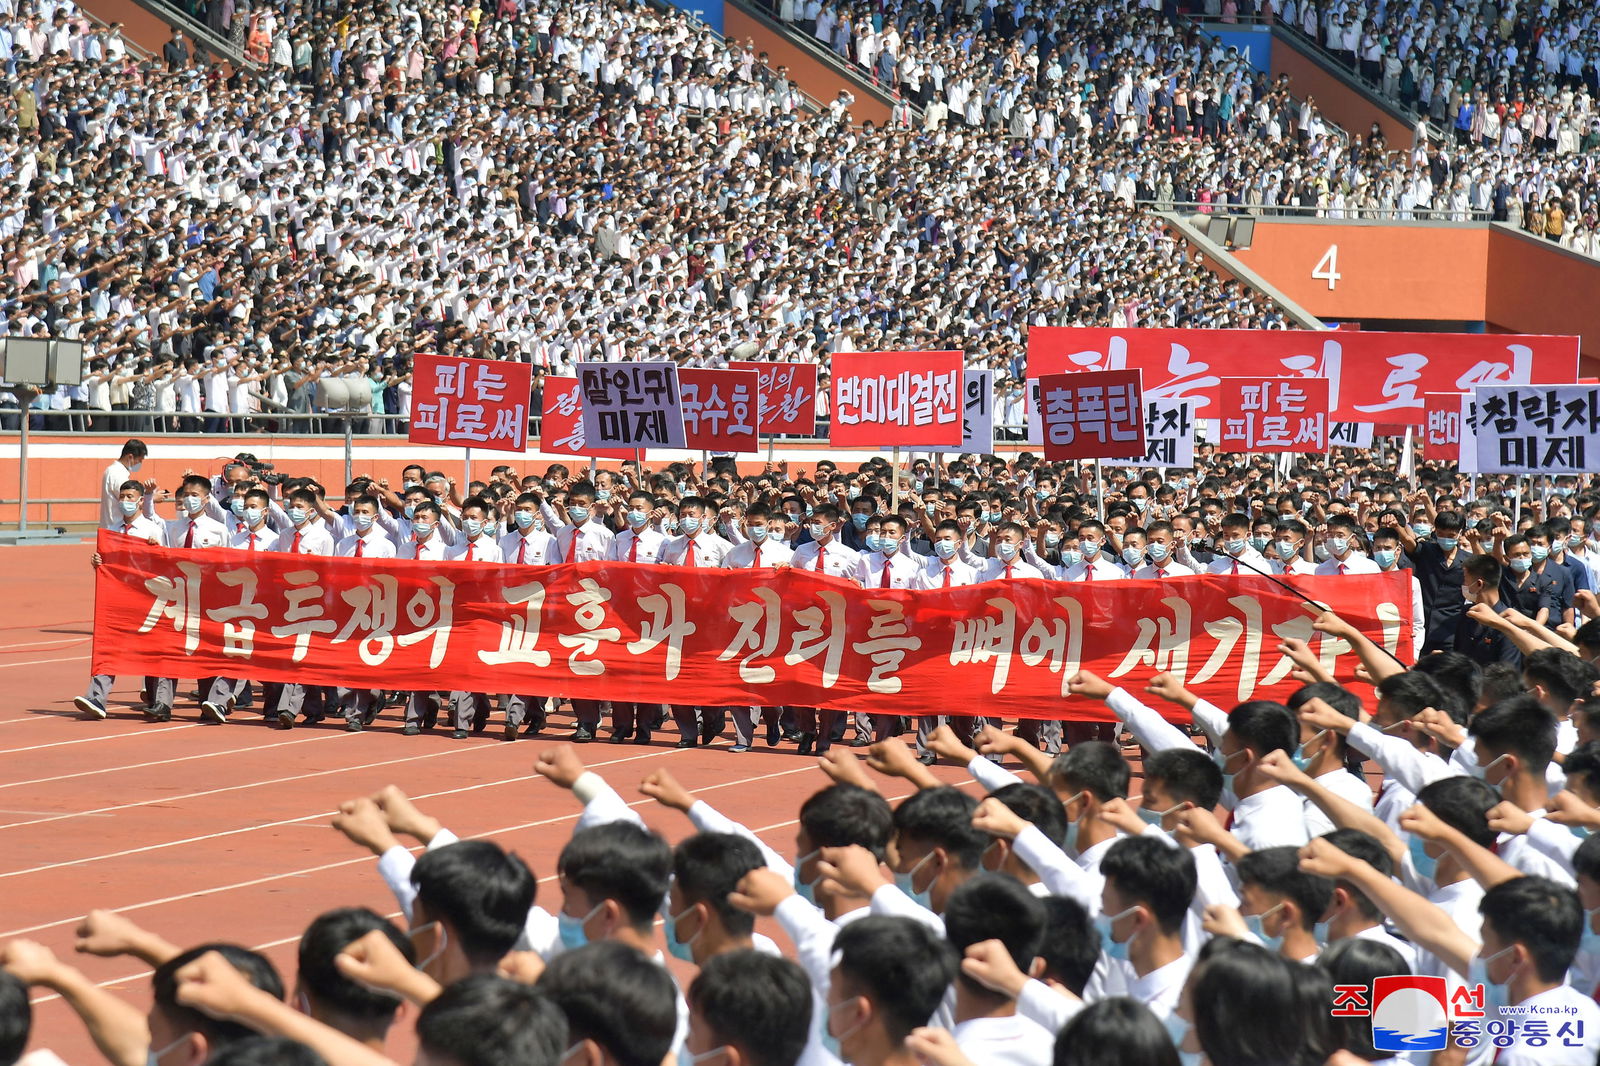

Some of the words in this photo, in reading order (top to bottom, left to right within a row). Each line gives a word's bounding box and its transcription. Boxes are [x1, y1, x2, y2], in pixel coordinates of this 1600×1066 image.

[1311, 243, 1341, 291] 4
[434, 361, 507, 401] 피는
[582, 366, 675, 407] 살인귀
[836, 369, 958, 427] 반미대결전
[1240, 381, 1308, 413] 피는
[413, 398, 524, 448] 피로써
[598, 409, 669, 445] 미제
[681, 383, 754, 436] 국수호
[1045, 382, 1139, 446] 총폭탄
[1223, 412, 1325, 450] 피로써
[1481, 390, 1600, 434] 침략자
[1499, 435, 1586, 470] 미제
[138, 561, 455, 670] 계급투쟁의
[477, 577, 697, 681] 교훈과
[716, 586, 922, 694] 진리를
